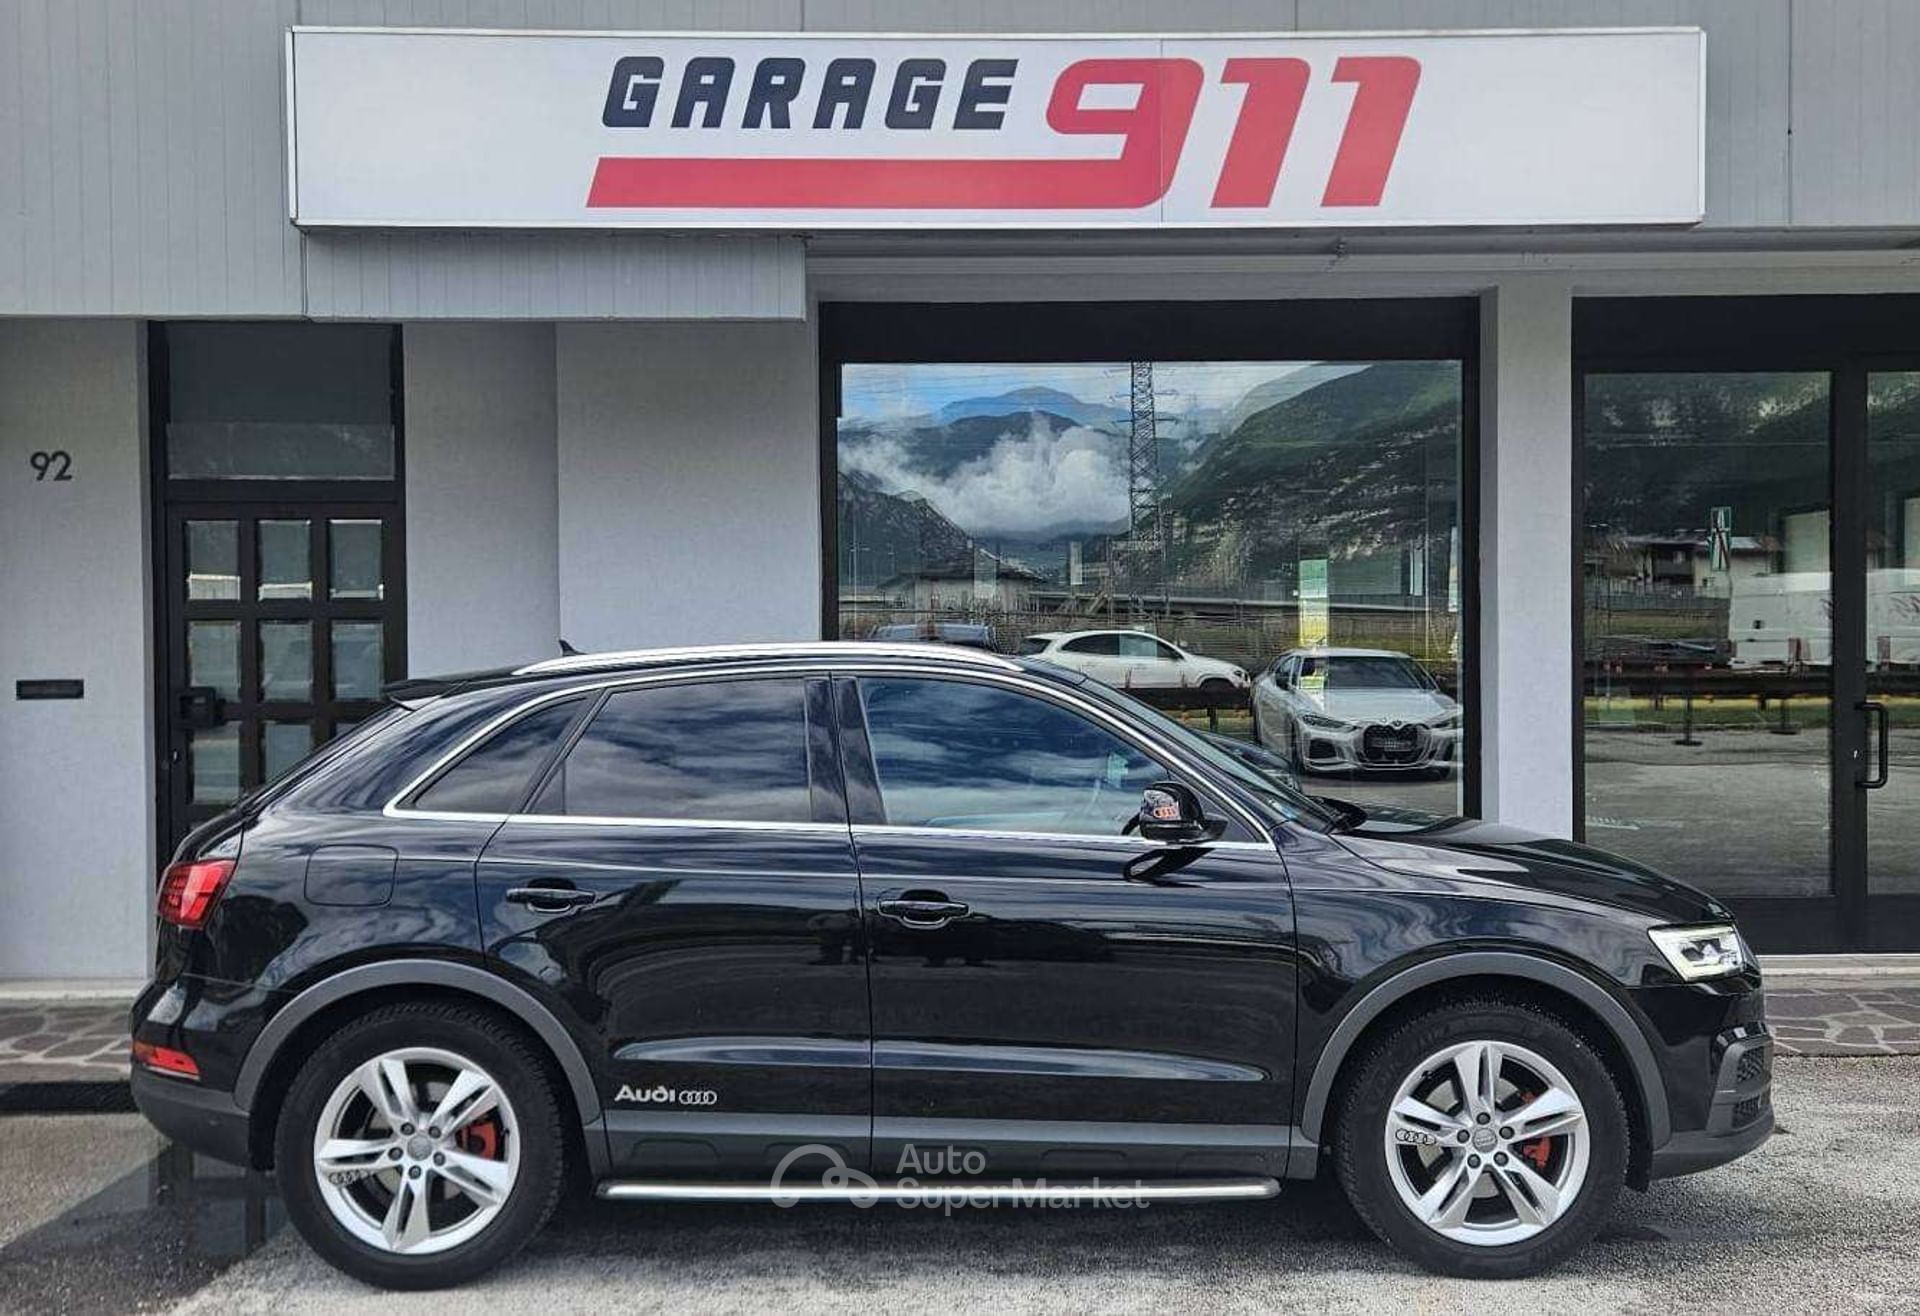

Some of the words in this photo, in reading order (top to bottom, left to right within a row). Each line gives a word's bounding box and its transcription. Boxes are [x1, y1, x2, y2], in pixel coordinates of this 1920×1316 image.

[602, 56, 1019, 130] GARAGE
[1045, 55, 1422, 209] 911
[30, 450, 73, 481] 92
